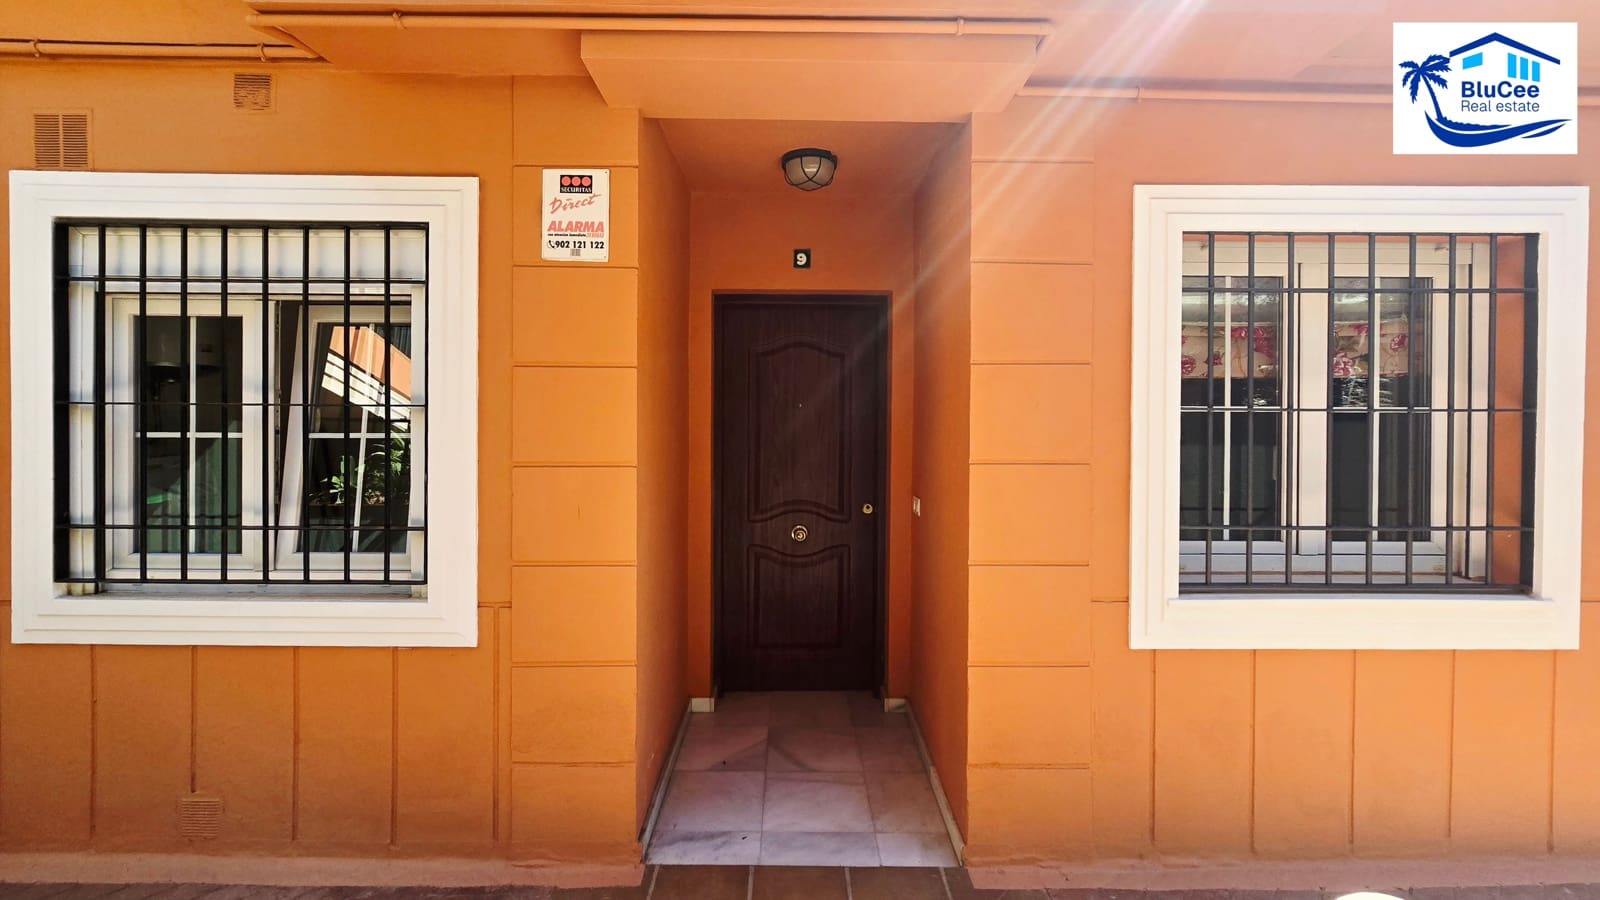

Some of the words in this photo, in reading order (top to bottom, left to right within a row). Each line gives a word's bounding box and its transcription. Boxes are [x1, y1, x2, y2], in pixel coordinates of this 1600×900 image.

[549, 193, 602, 214] Direct
[547, 220, 604, 232] ALARMA
[555, 240, 570, 249] 902
[573, 240, 586, 249] 121
[590, 241, 605, 249] 122
[796, 252, 807, 266] 9
